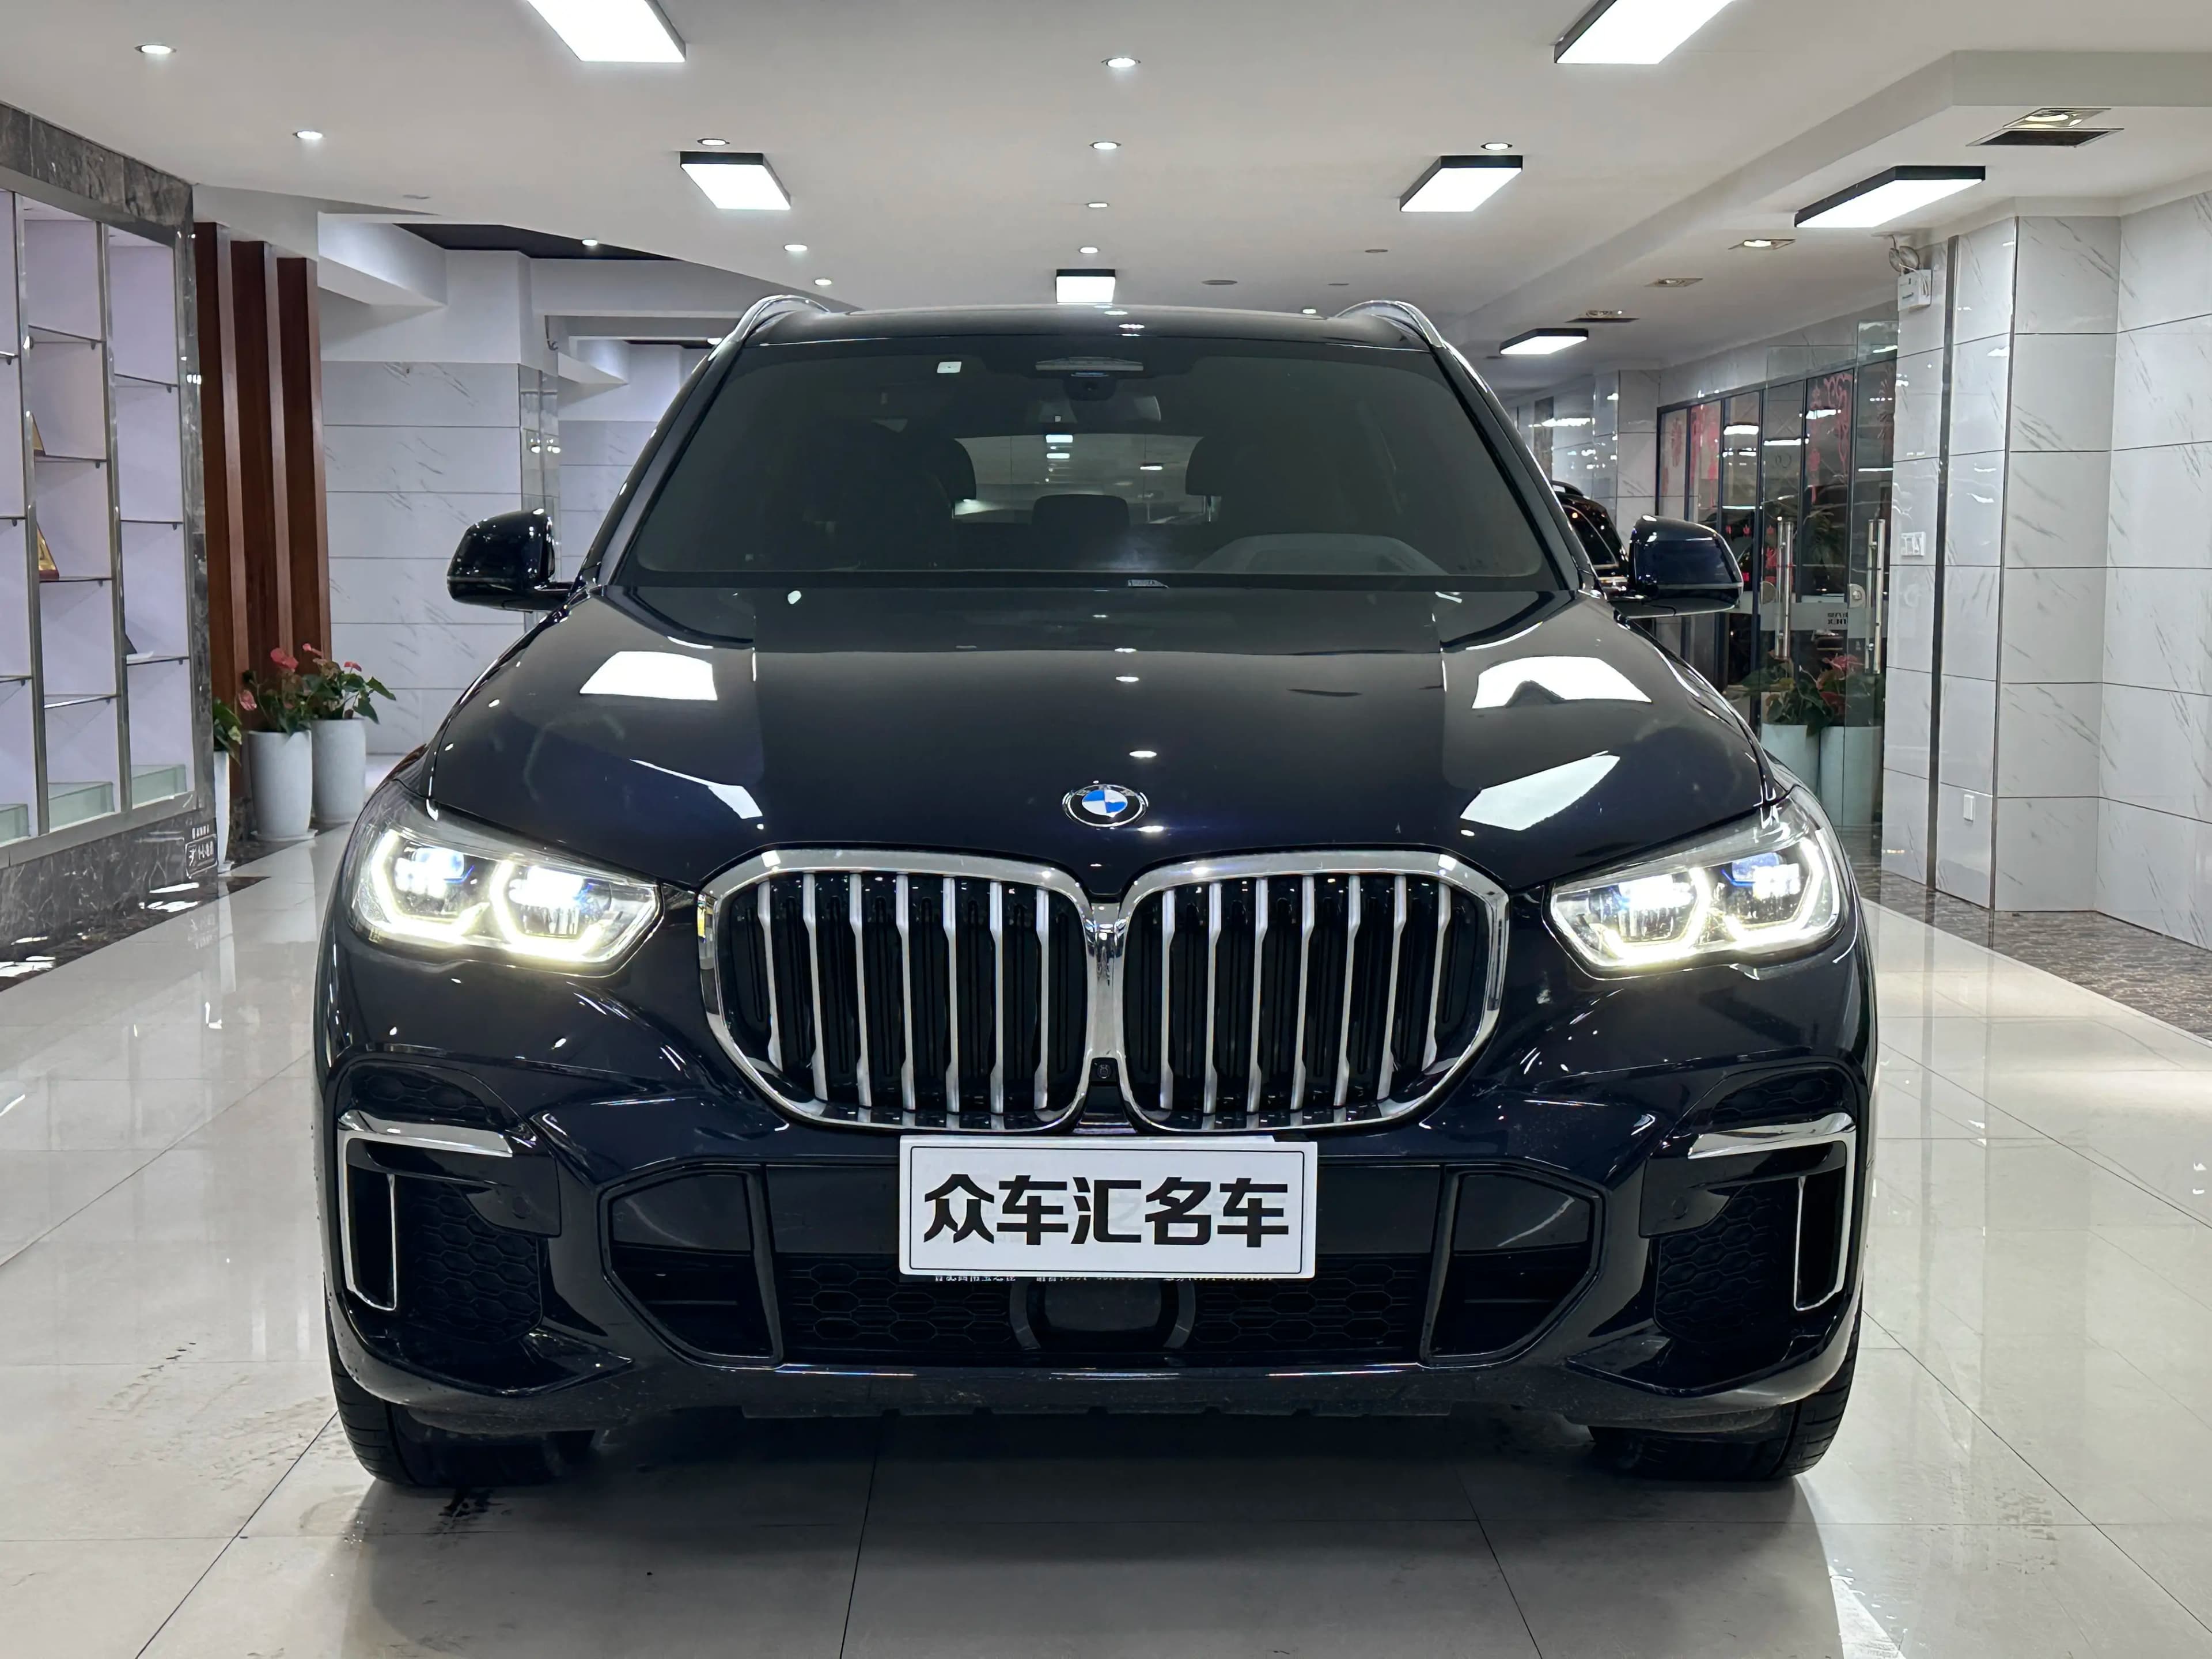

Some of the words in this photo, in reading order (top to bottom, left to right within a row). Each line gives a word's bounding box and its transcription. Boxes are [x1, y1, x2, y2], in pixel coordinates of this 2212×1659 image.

[923, 1173, 1289, 1248] 众车汇名车
